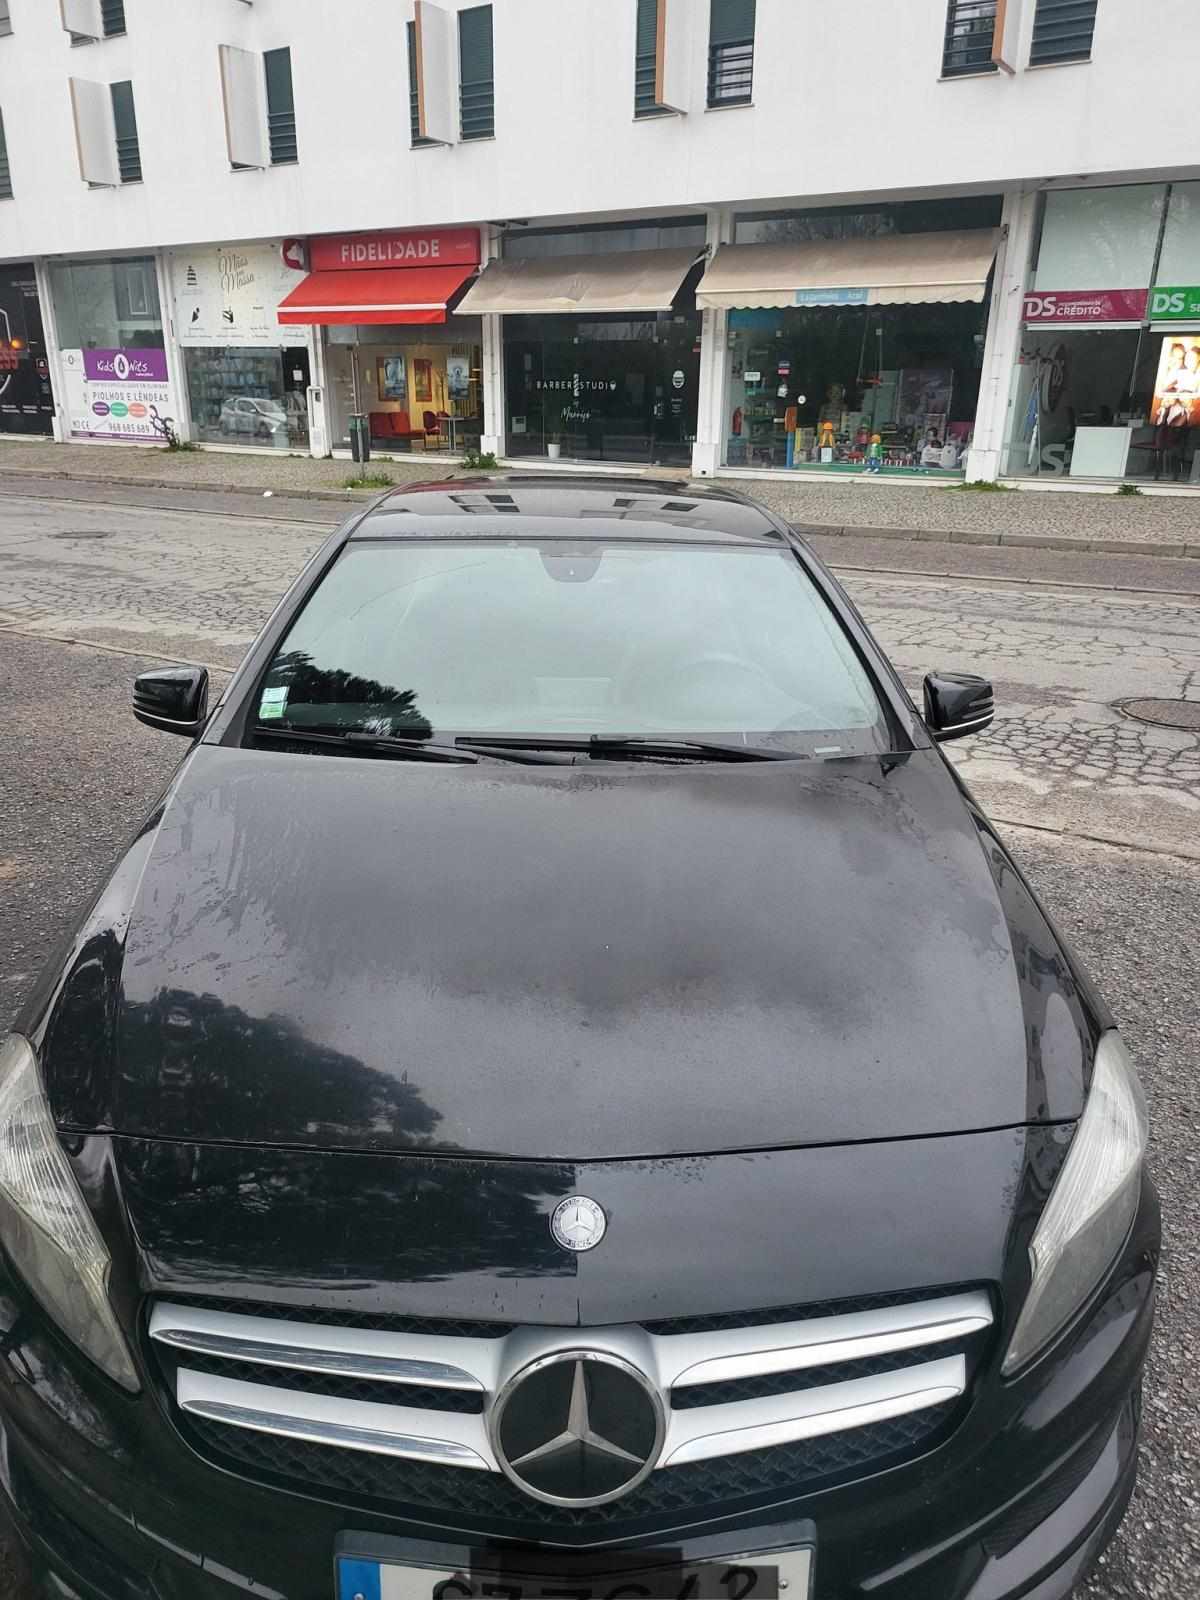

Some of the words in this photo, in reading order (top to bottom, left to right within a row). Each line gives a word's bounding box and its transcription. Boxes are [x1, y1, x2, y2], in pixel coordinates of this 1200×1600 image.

[341, 239, 440, 262] FIDELIDADE
[1024, 297, 1057, 317] DS
[1056, 305, 1101, 316] CRÉDITO
[1151, 293, 1186, 313] DS
[97, 360, 115, 372] Kids
[128, 360, 148, 372] Nits
[536, 380, 572, 390] BARBER
[92, 391, 124, 401] PIOLHOS
[127, 392, 131, 401] E
